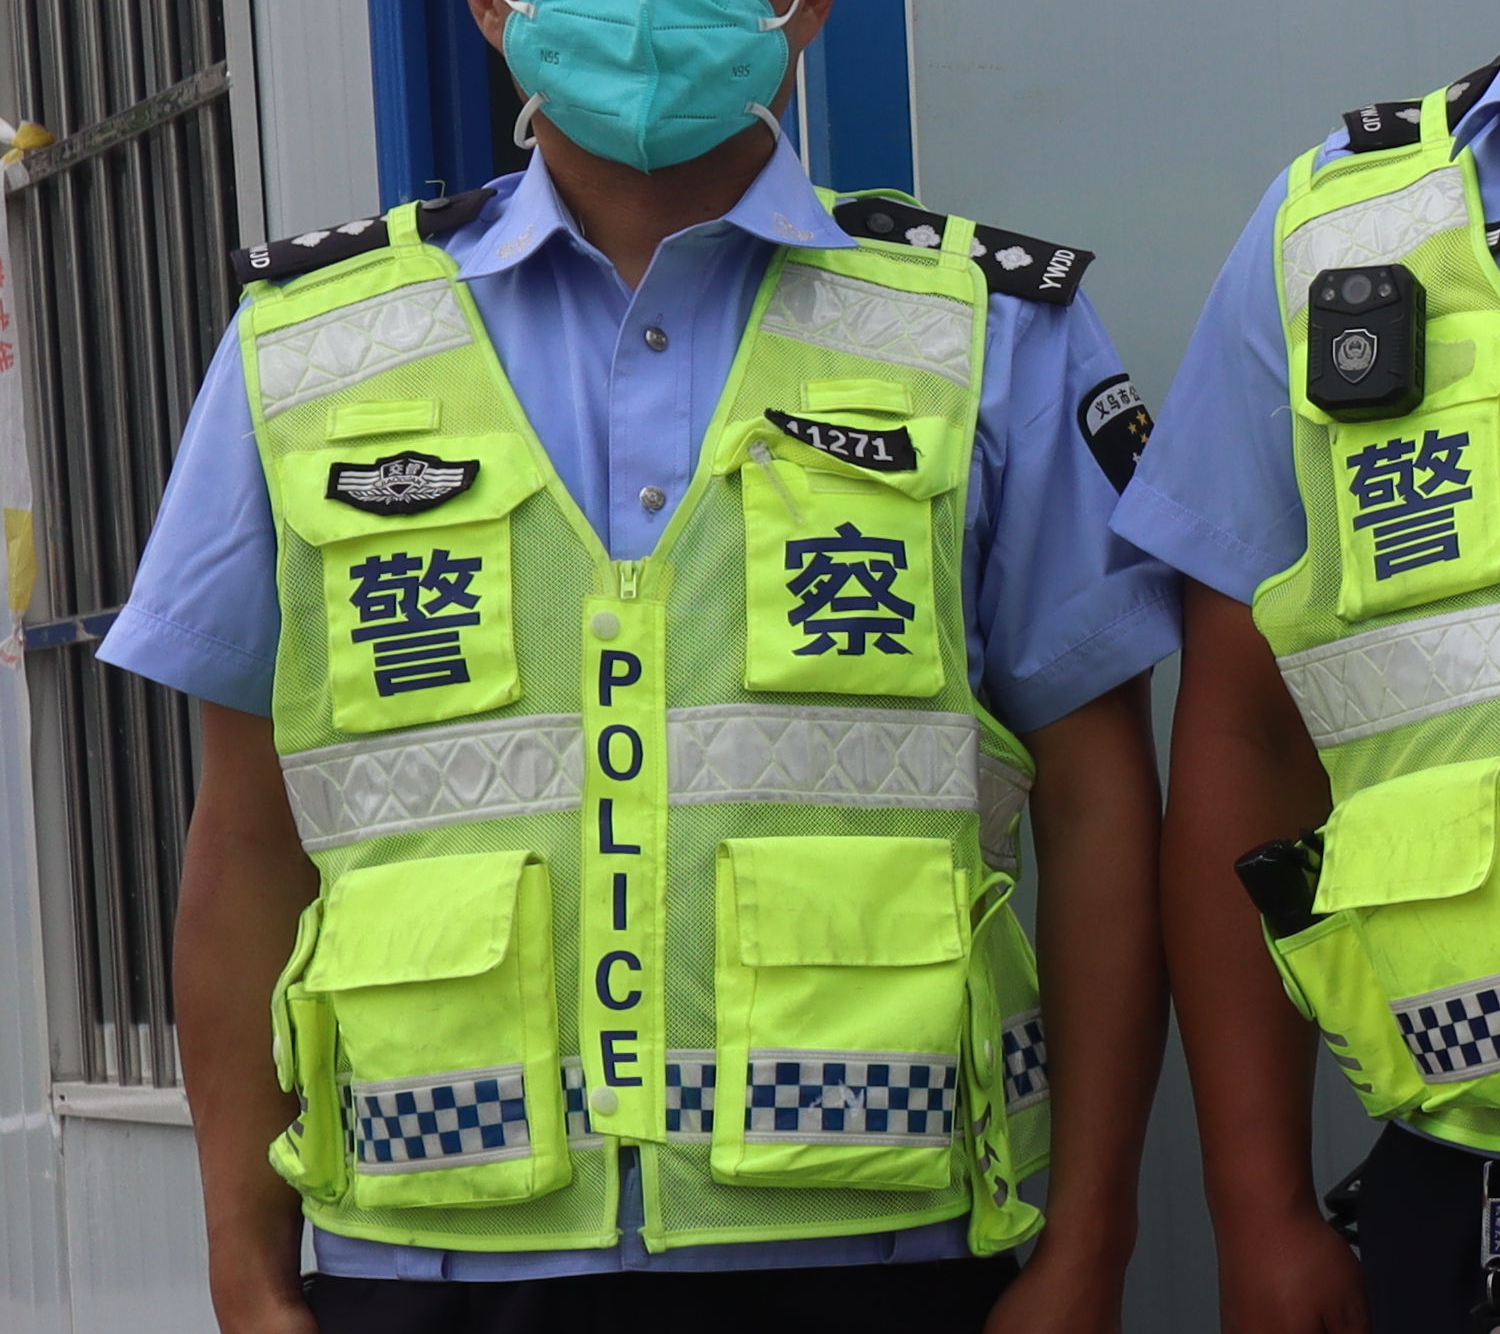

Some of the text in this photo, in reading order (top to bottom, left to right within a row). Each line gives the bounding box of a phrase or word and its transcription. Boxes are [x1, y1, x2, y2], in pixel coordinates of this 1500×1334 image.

[1039, 249, 1076, 290] YWJD
[1348, 429, 1474, 581] 警
[348, 522, 916, 698] 警 察
[594, 649, 645, 1089] POLICE
